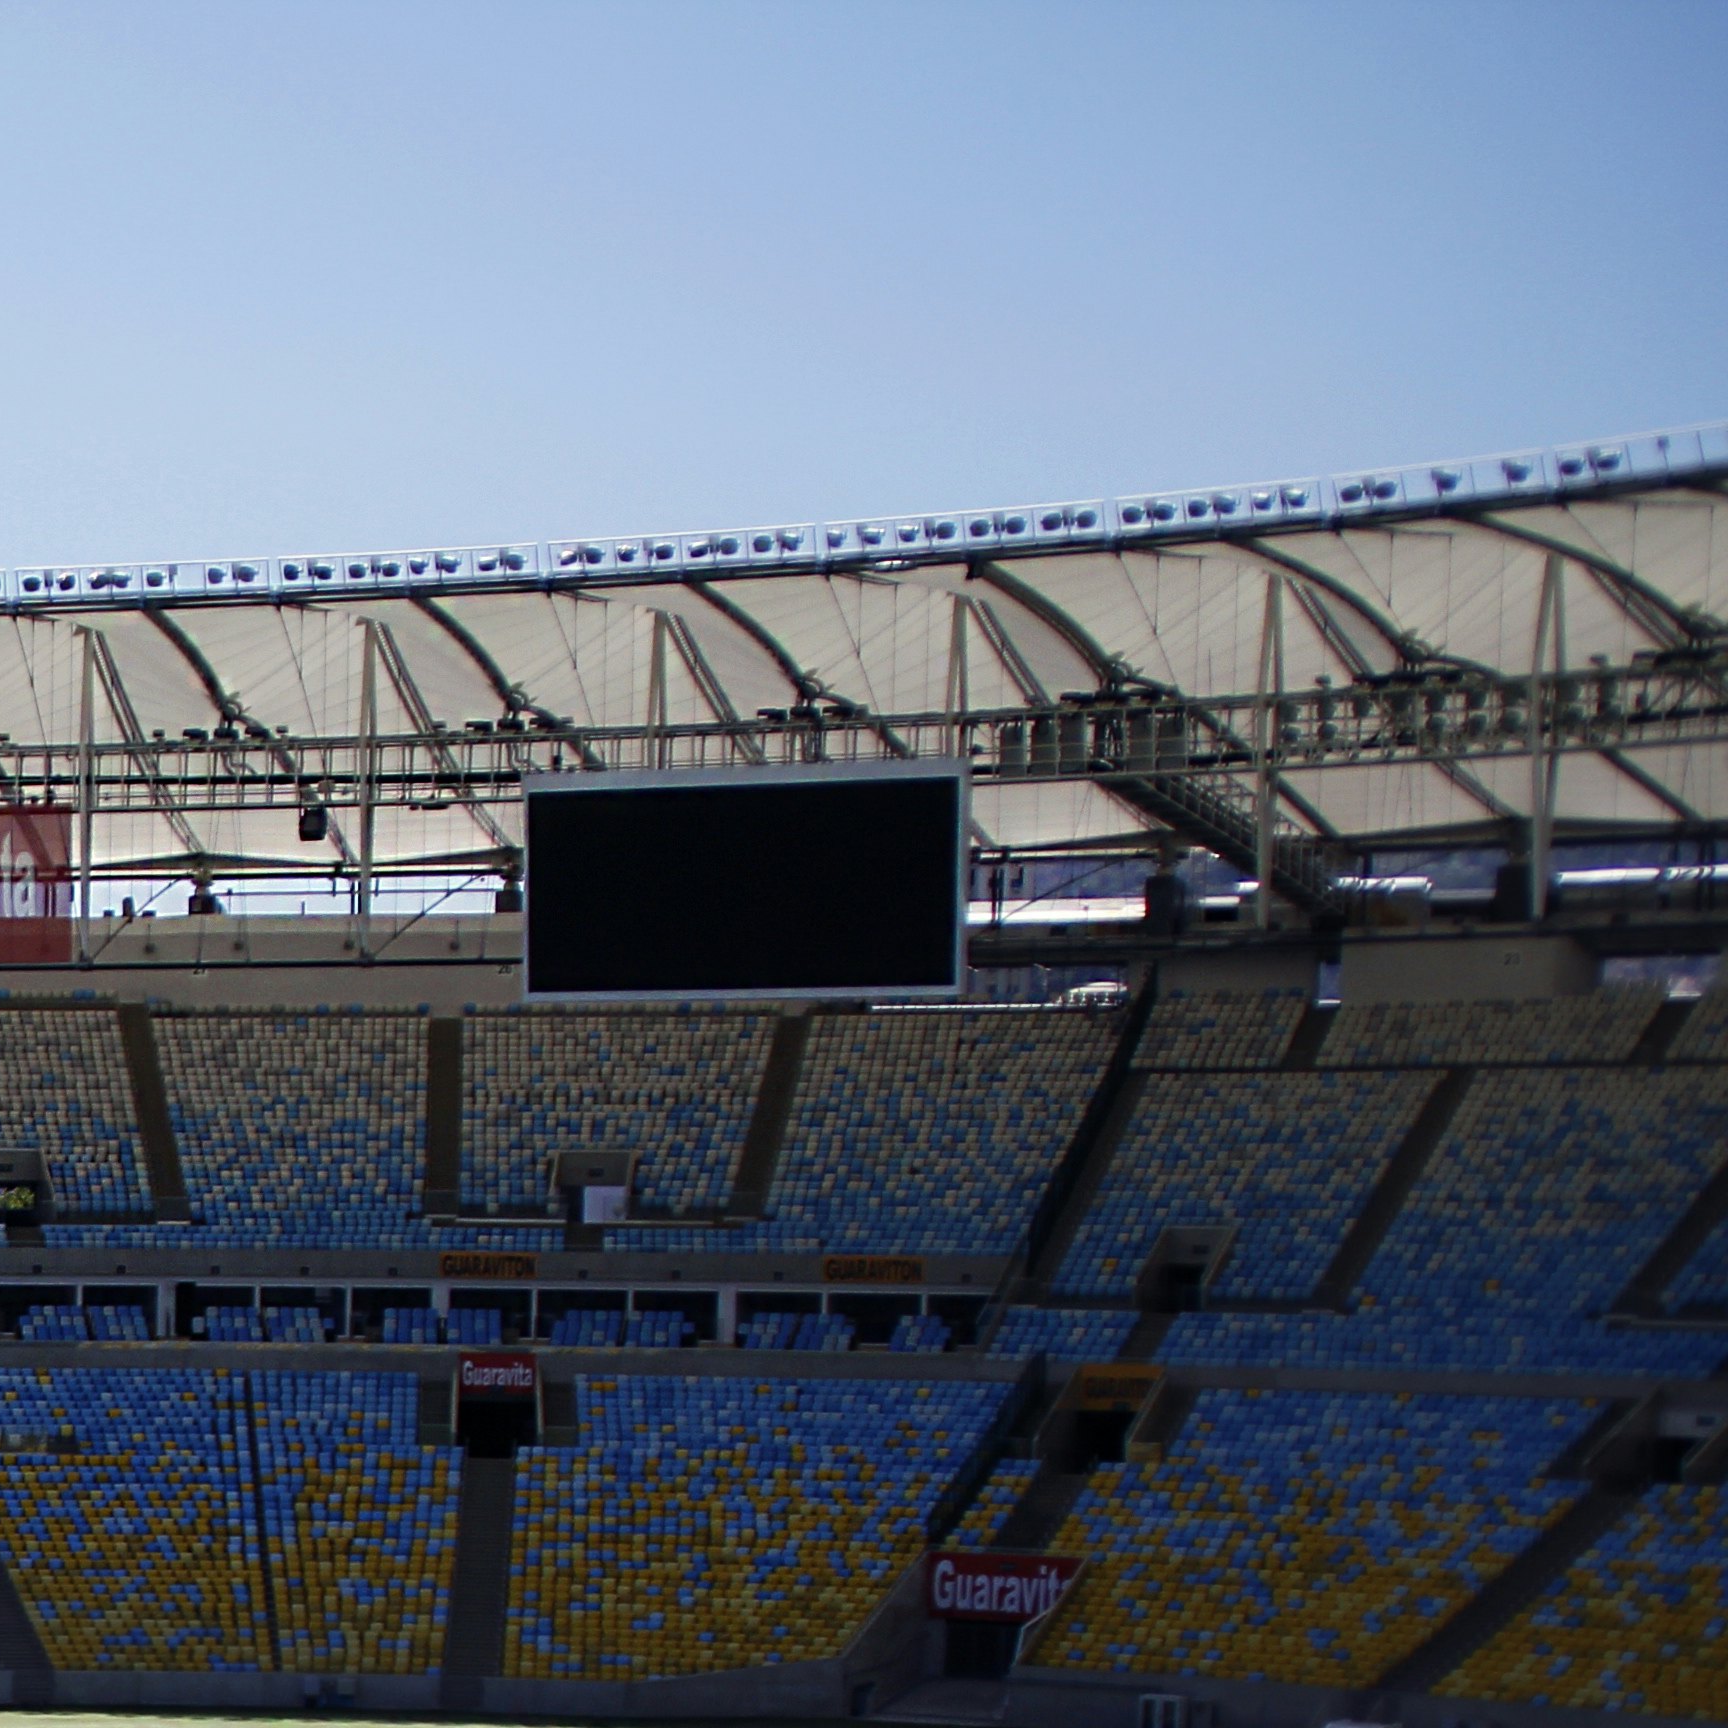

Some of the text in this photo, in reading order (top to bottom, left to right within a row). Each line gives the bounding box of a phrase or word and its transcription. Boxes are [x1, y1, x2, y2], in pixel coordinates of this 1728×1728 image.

[441, 1255, 536, 1277] GUARAVITON
[826, 1259, 922, 1281] GUARAVITON
[462, 1360, 533, 1387] Guaravita
[934, 1559, 1073, 1615] Guaravit
